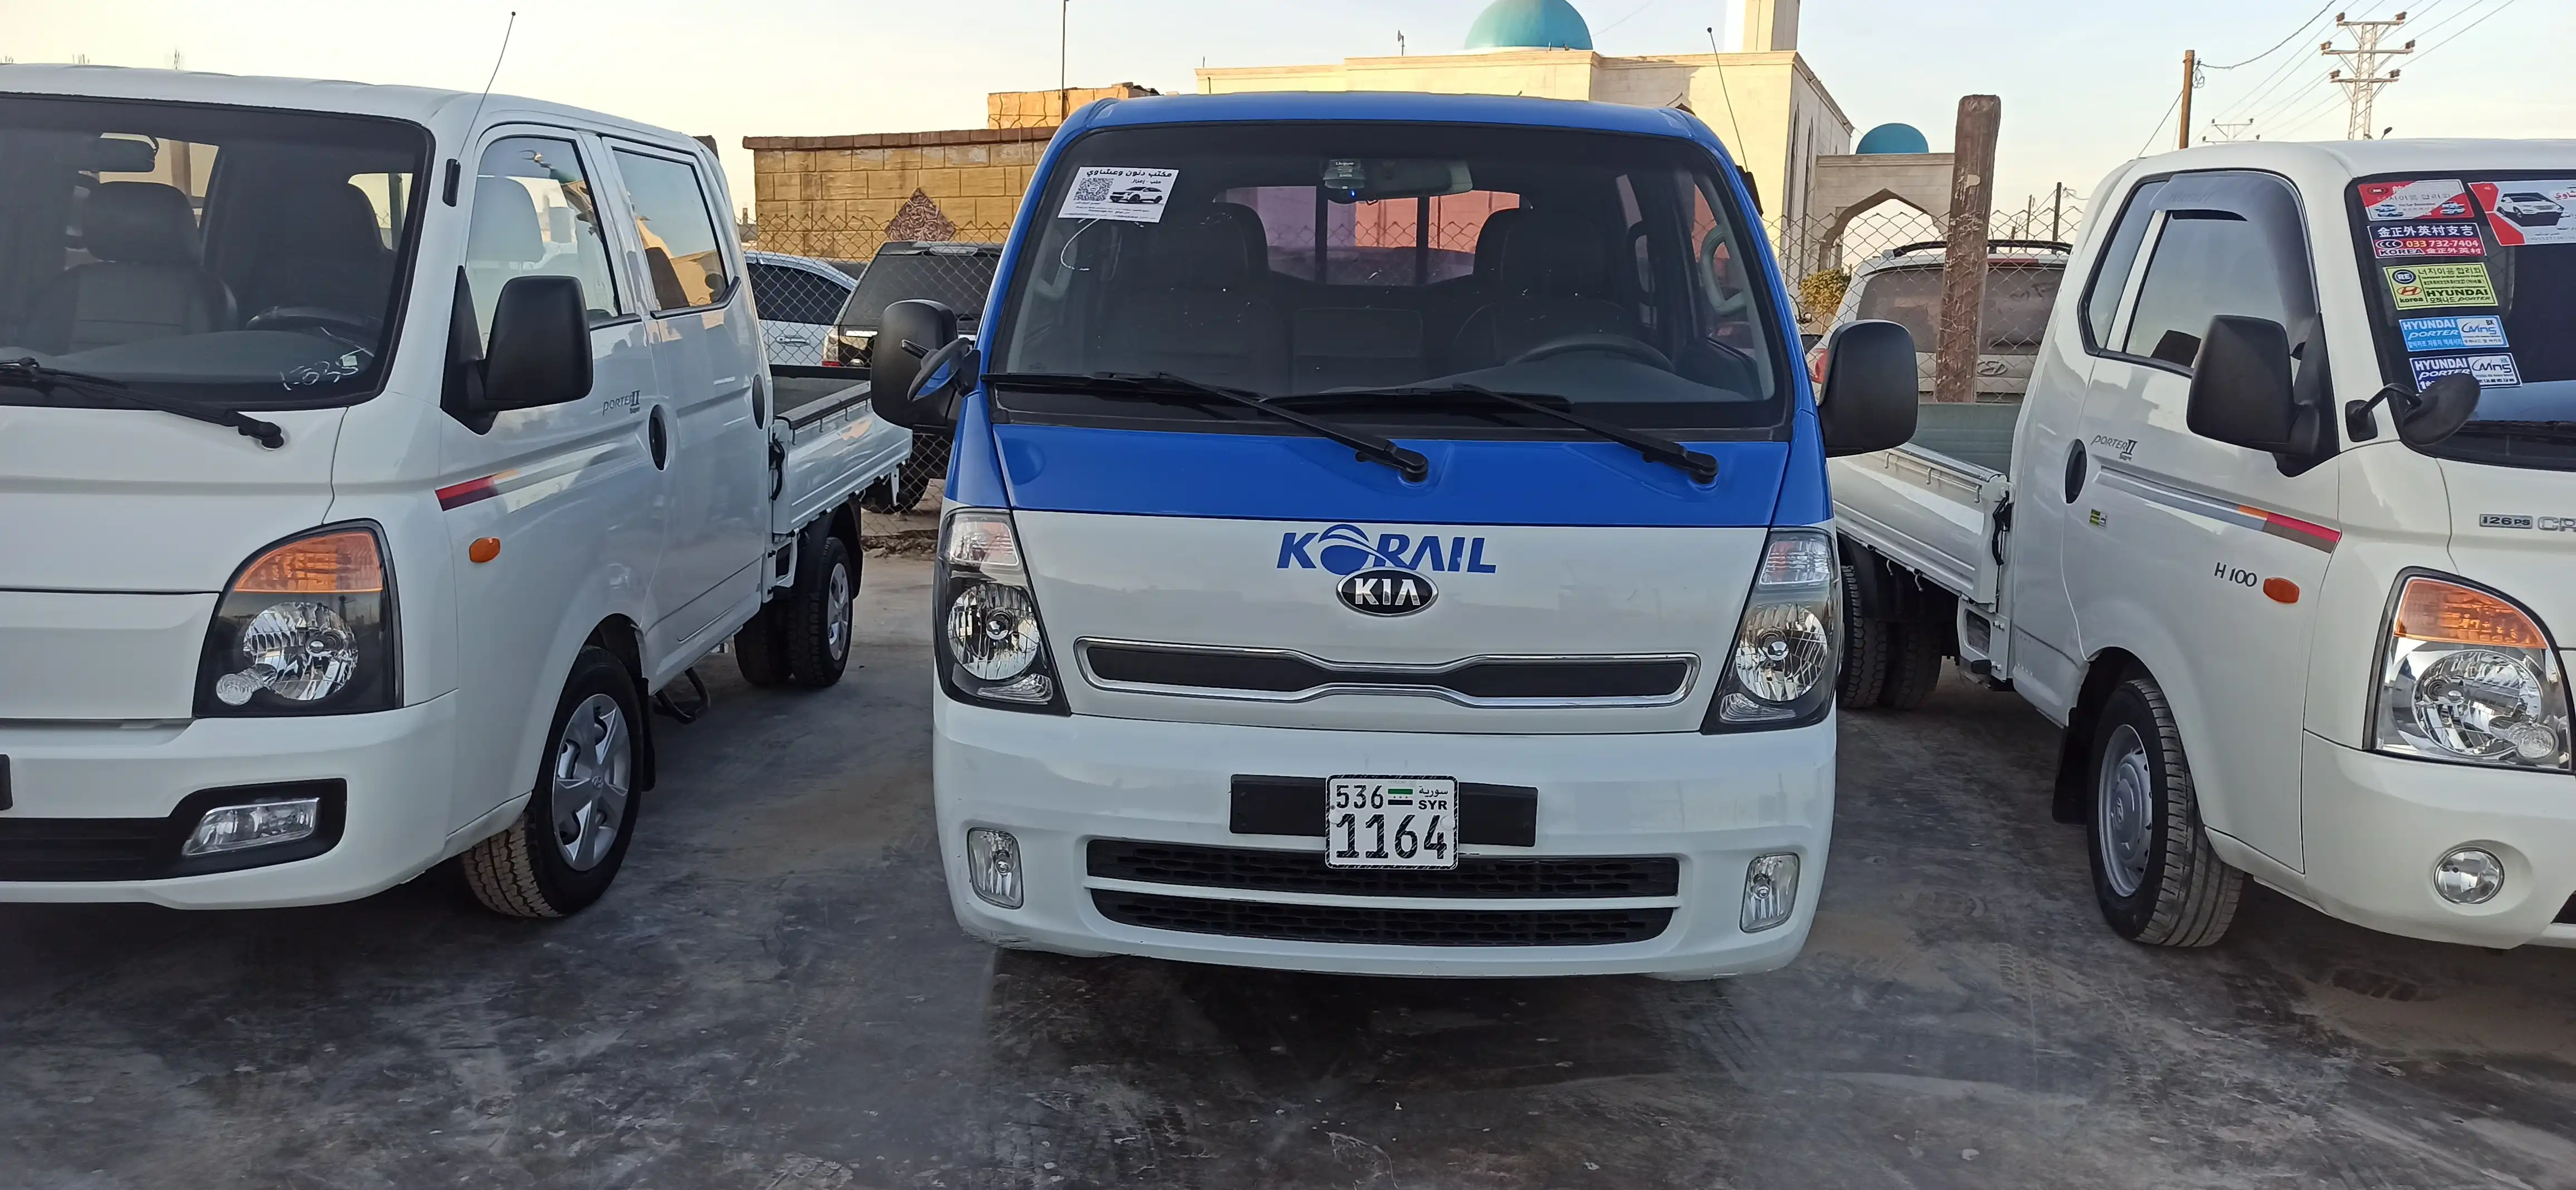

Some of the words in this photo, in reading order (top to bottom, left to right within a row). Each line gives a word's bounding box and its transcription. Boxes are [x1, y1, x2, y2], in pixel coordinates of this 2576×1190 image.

[2378, 248, 2426, 256] KOREA
[2427, 289, 2489, 297] HYUNDAI
[2402, 319, 2456, 331] HYUNDAI
[2407, 329, 2460, 340] PORTER
[2414, 358, 2468, 371] HYUNDAI
[2418, 369, 2470, 380] PORTER
[1276, 523, 1497, 576] KORAIL
[2229, 568, 2257, 587] 100
[1354, 578, 1421, 606] KIA
[1336, 784, 1384, 809] 536
[1418, 785, 1448, 798] سورية
[1418, 799, 1448, 810] SYR
[1336, 813, 1448, 860] 1164
